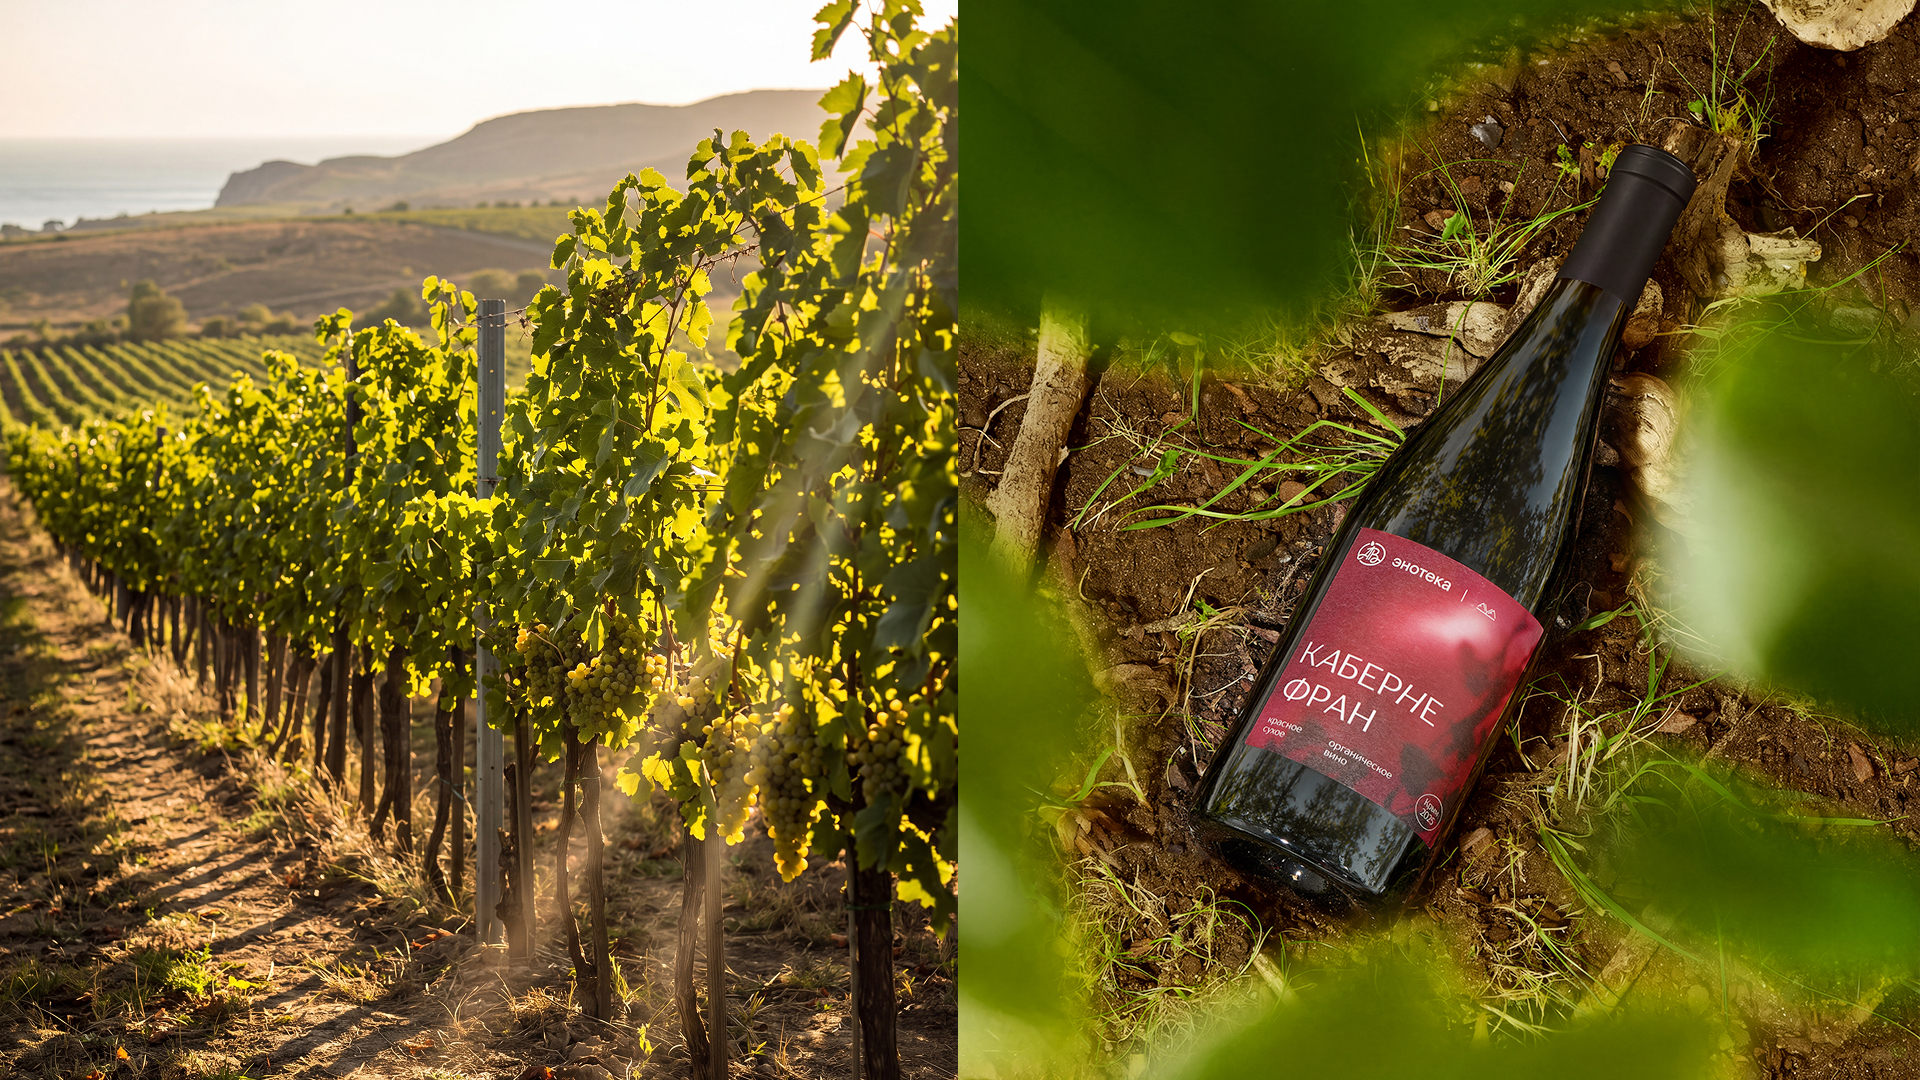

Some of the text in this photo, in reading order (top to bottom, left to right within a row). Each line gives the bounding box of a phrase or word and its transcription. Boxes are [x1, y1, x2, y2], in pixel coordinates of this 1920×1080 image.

[1391, 557, 1452, 592] энотека
[1299, 641, 1444, 727] КАБЕРНЕ
[1283, 677, 1377, 732] ФРАН
[1262, 726, 1286, 738] сухое
[1267, 717, 1303, 733] красное
[1323, 749, 1348, 766] вино
[1328, 740, 1393, 779] органическое
[1420, 808, 1435, 825] 2025
